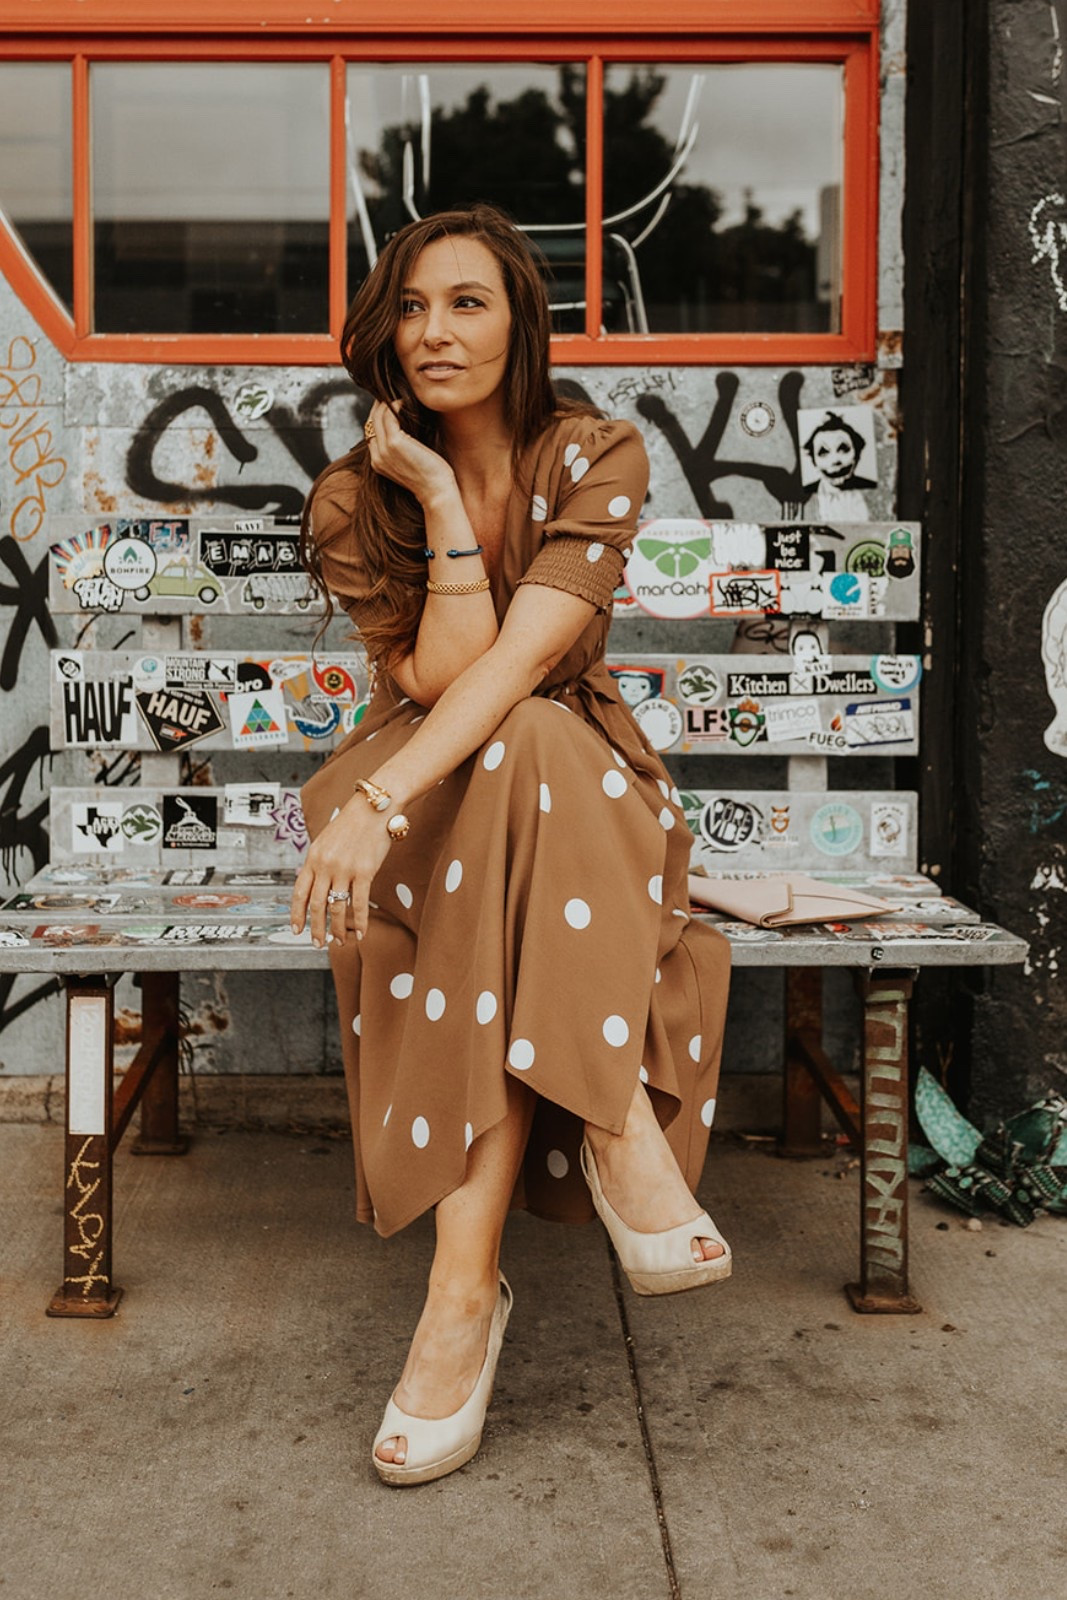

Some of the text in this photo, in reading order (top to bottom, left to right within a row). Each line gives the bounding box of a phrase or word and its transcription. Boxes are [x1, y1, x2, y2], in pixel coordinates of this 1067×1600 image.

[773, 530, 802, 547] just
[781, 544, 796, 557] be
[775, 557, 804, 568] nice
[730, 673, 876, 695] Kitchen Dwellers
[64, 676, 133, 743] HAUF
[147, 692, 211, 730] HAUF
[636, 702, 669, 722] TORING
